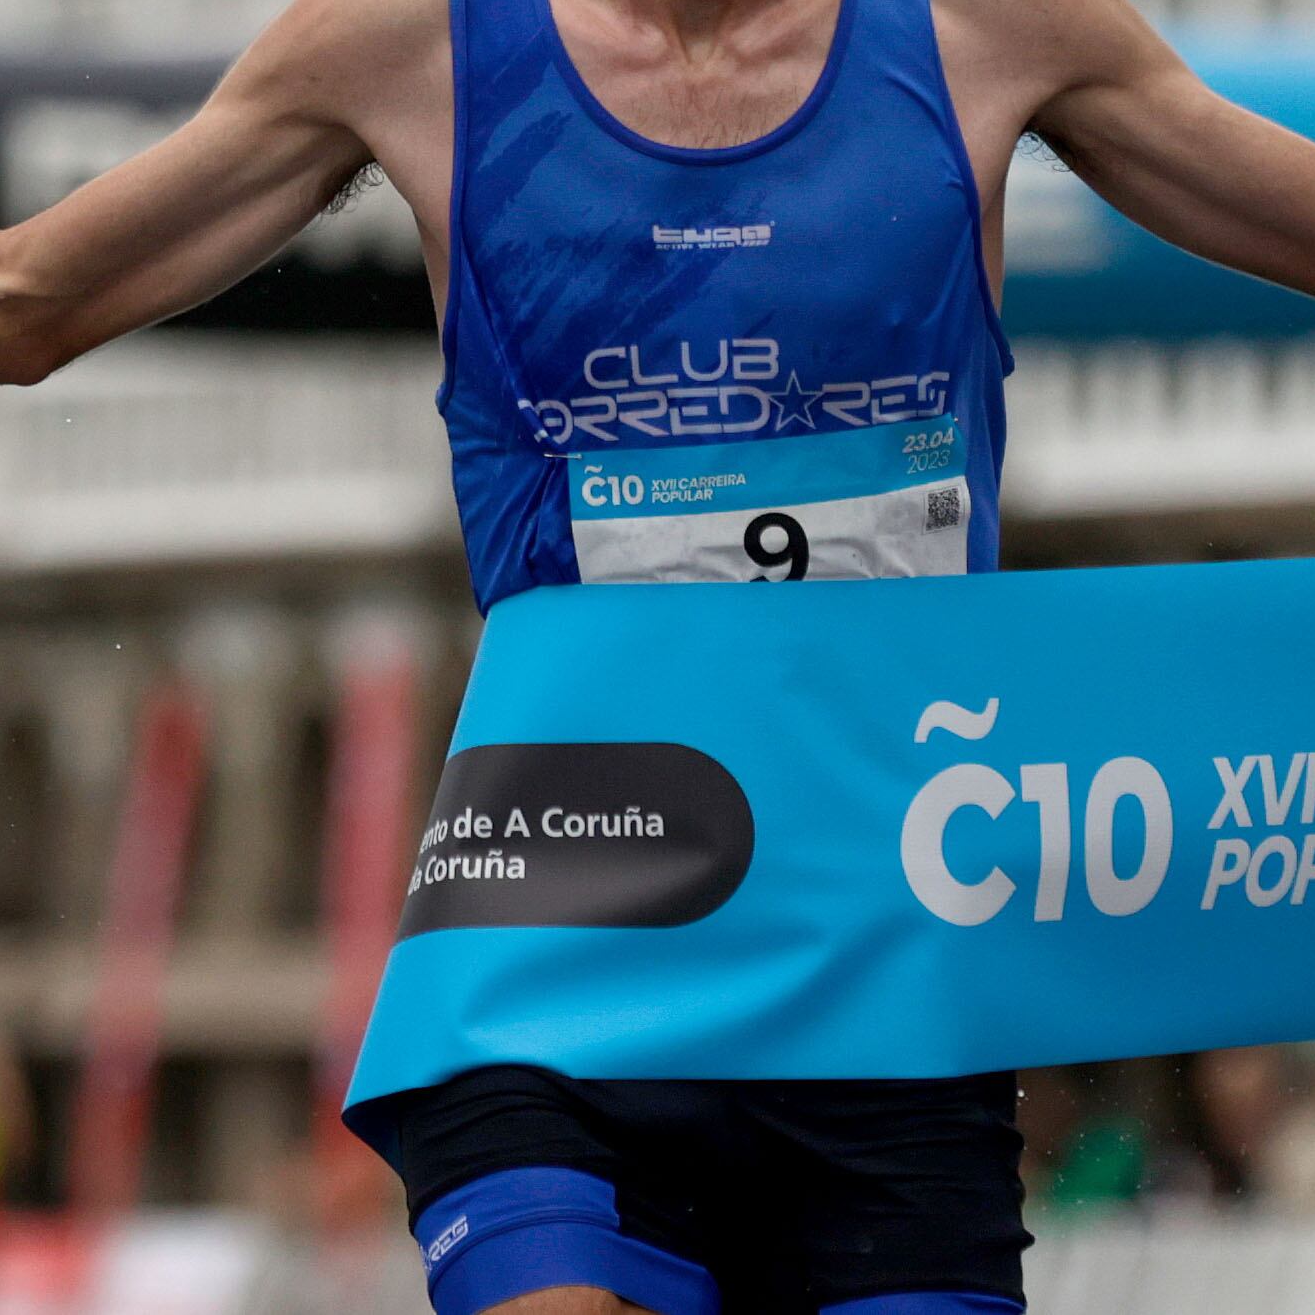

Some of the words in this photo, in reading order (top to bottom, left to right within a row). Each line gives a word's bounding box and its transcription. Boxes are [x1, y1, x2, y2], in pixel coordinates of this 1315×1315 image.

[583, 338, 779, 390] CLUB
[902, 426, 955, 454] 23.04
[906, 449, 951, 474] 2023
[651, 488, 714, 504] POPULAR
[678, 473, 747, 490] CARREIRA
[744, 512, 809, 582] 9
[453, 807, 494, 838] de
[503, 808, 531, 838] A
[541, 805, 665, 838] Coruña
[424, 849, 526, 886] Coruña
